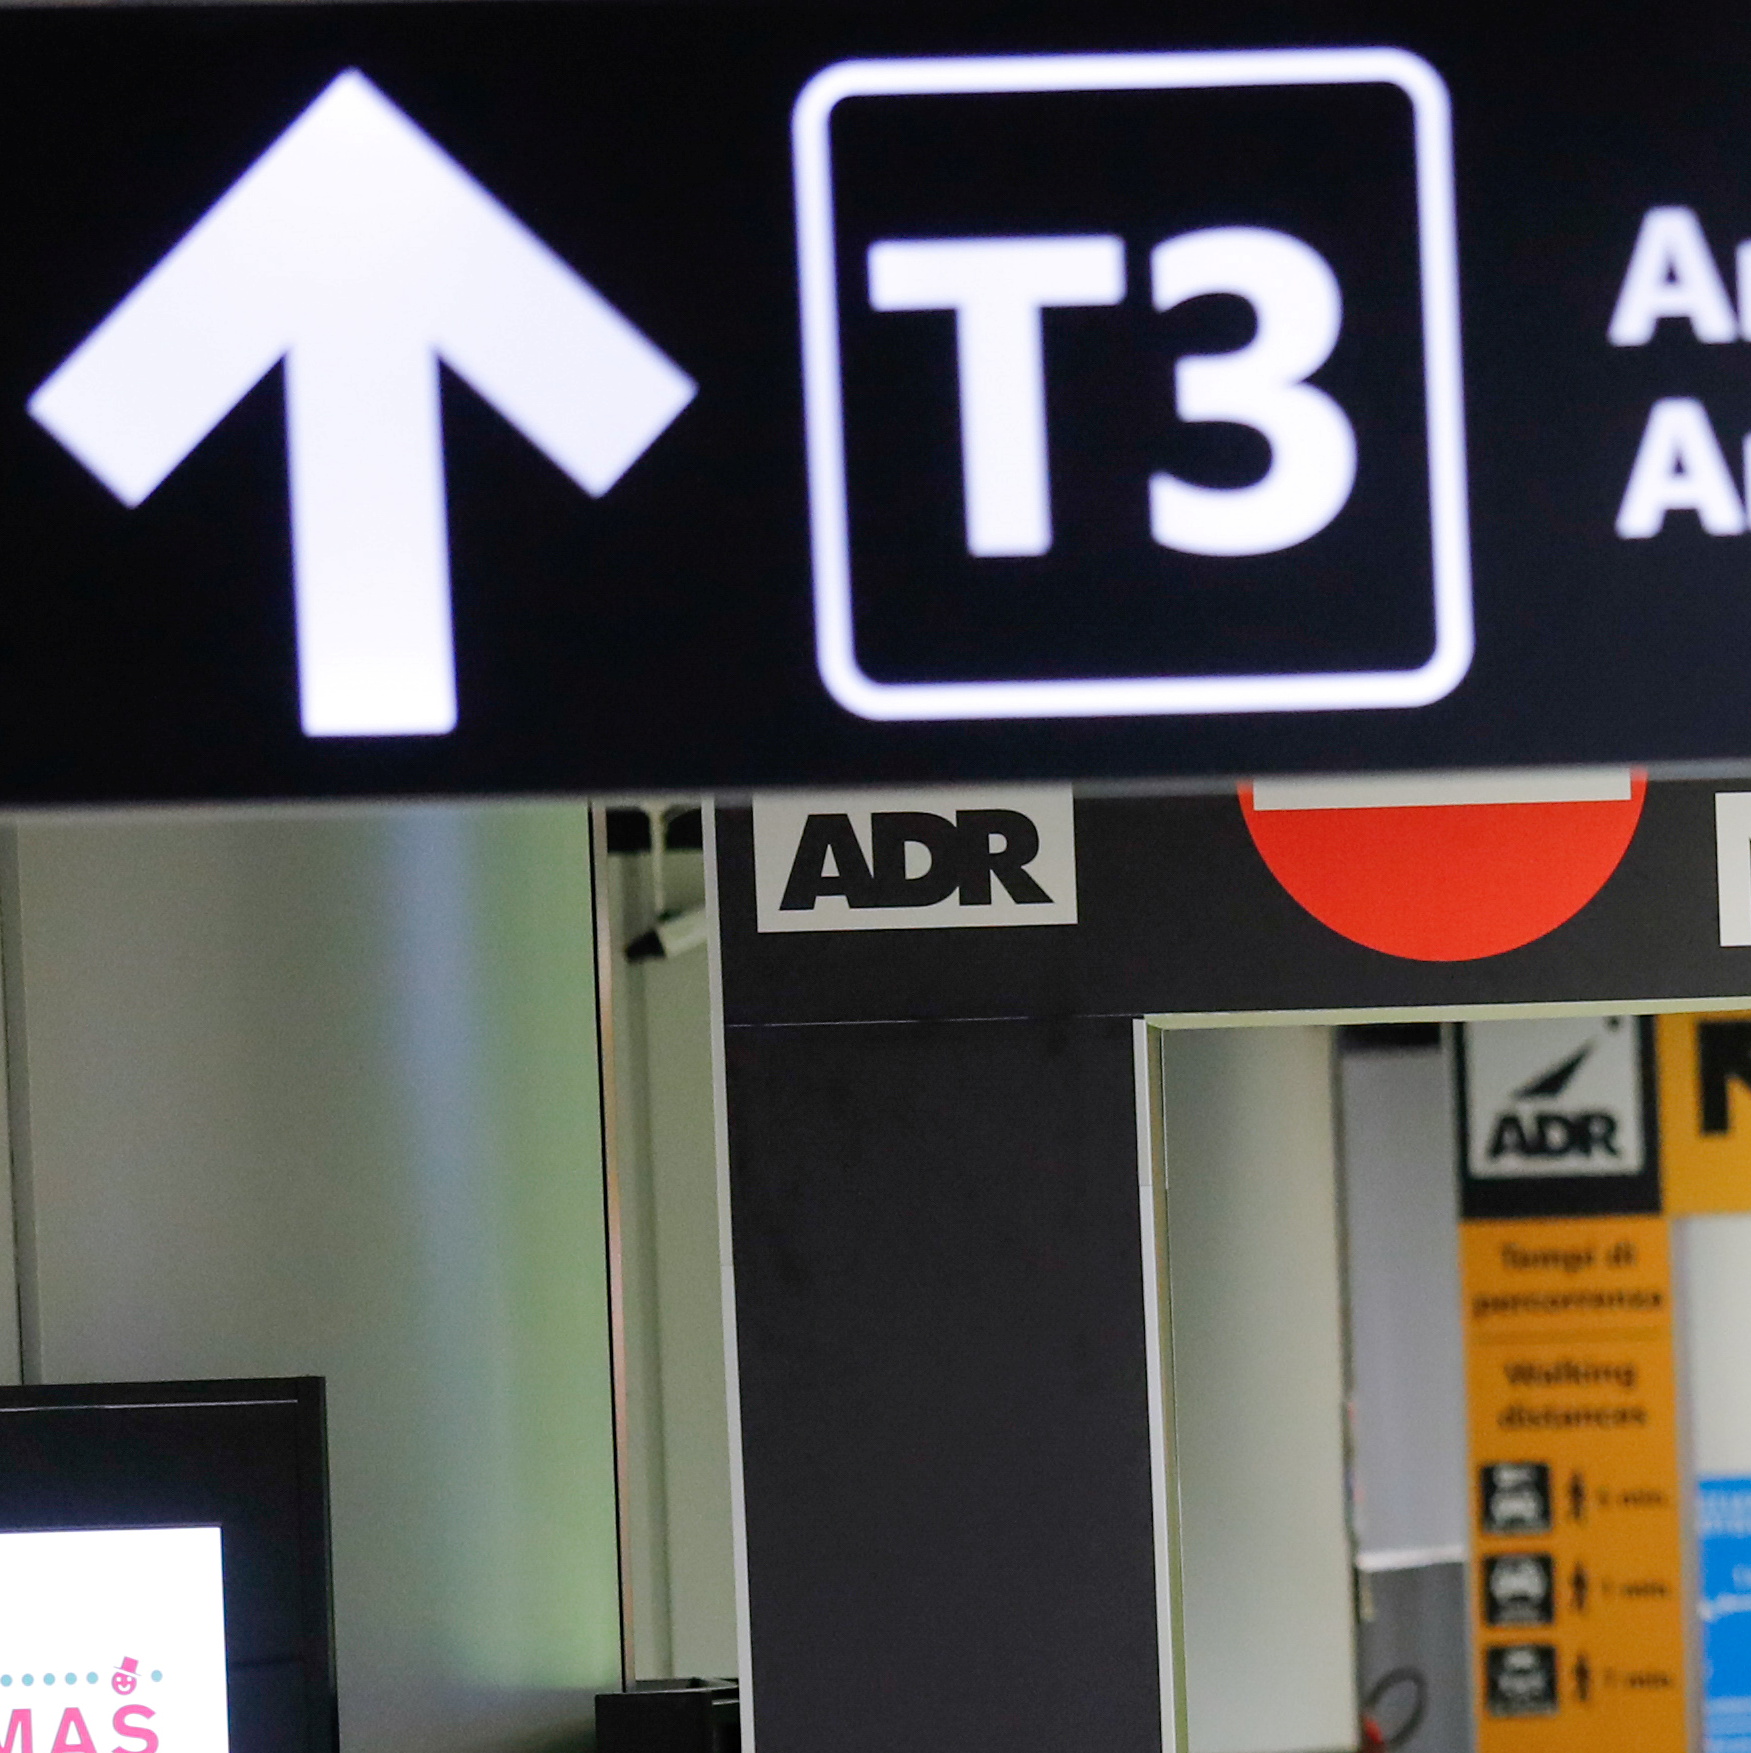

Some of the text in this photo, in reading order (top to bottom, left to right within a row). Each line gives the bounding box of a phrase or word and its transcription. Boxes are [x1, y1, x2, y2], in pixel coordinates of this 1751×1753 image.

[867, 224, 1359, 558] T3
[778, 808, 1056, 911] ADR
[1486, 1111, 1622, 1162] ADR
